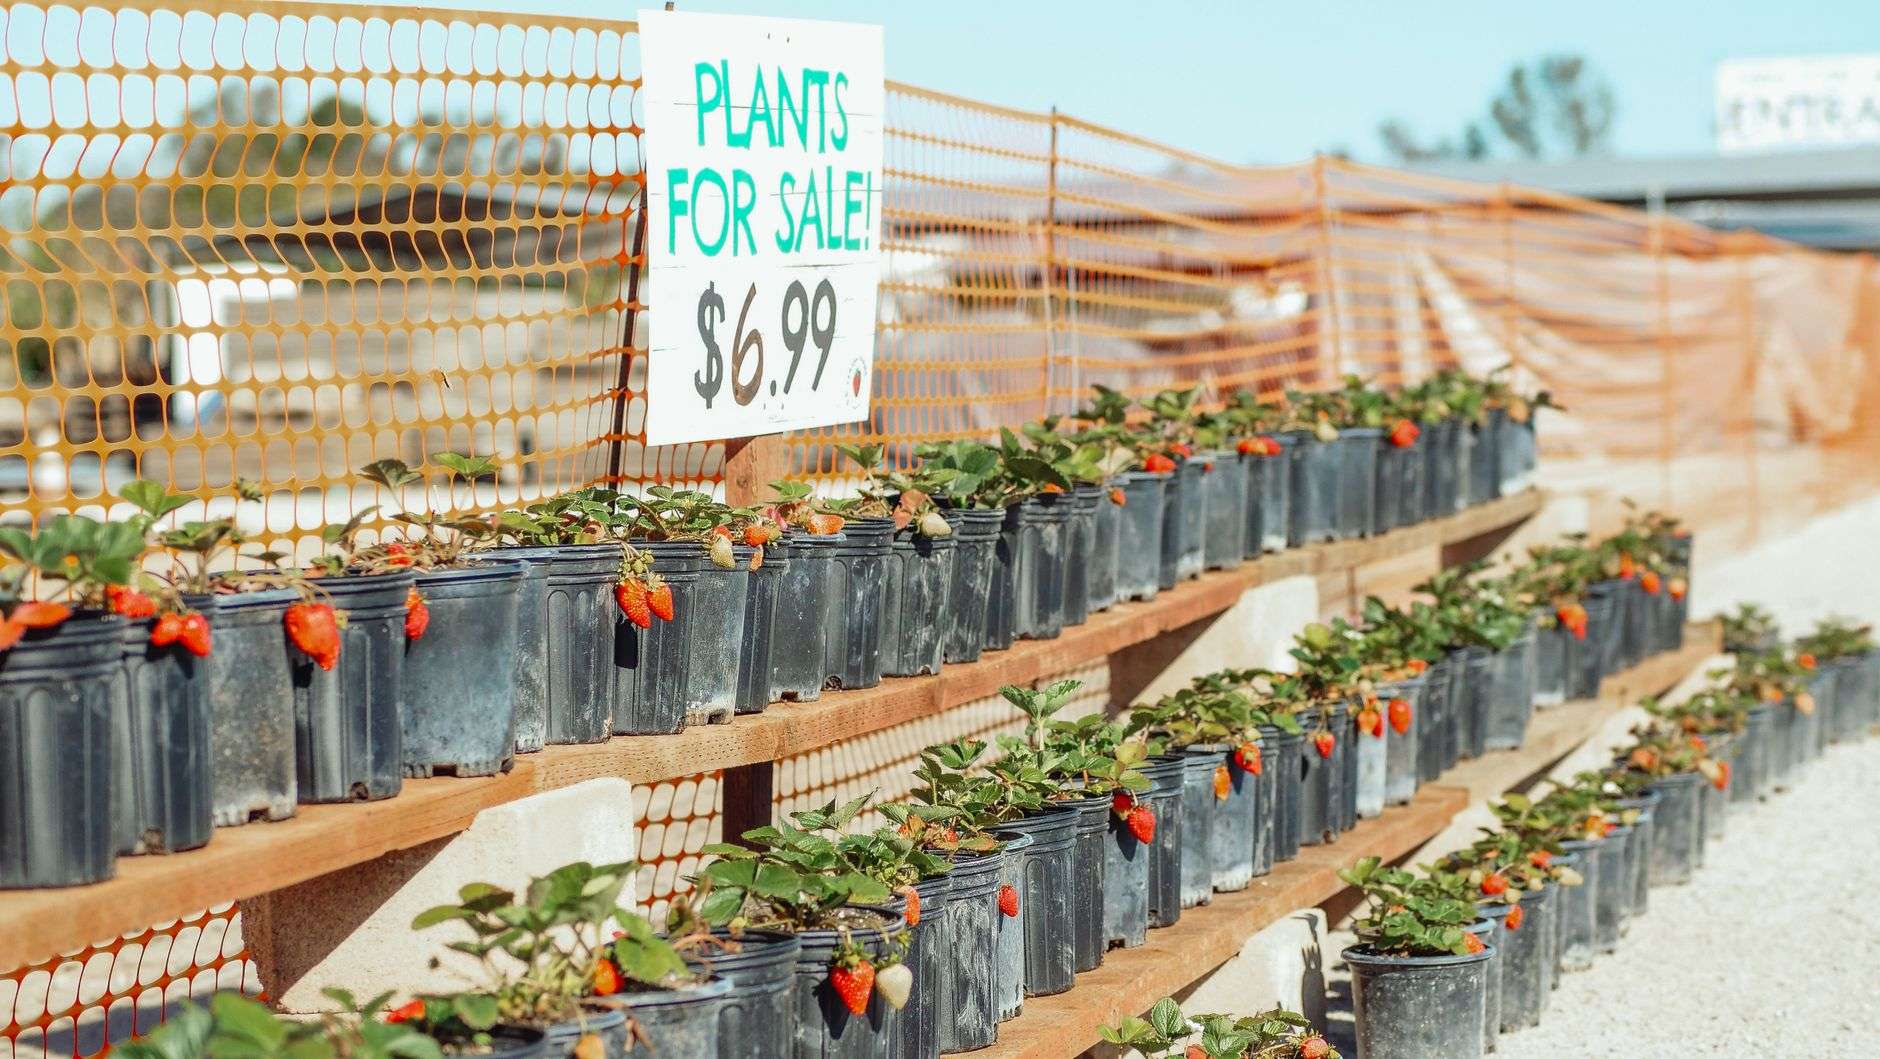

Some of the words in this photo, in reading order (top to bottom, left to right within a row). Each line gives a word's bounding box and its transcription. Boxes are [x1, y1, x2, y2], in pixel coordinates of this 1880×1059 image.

[694, 58, 849, 154] PLANTS
[667, 167, 758, 258] FOR
[775, 165, 872, 255] SALE!
[695, 279, 837, 410] $6.99
